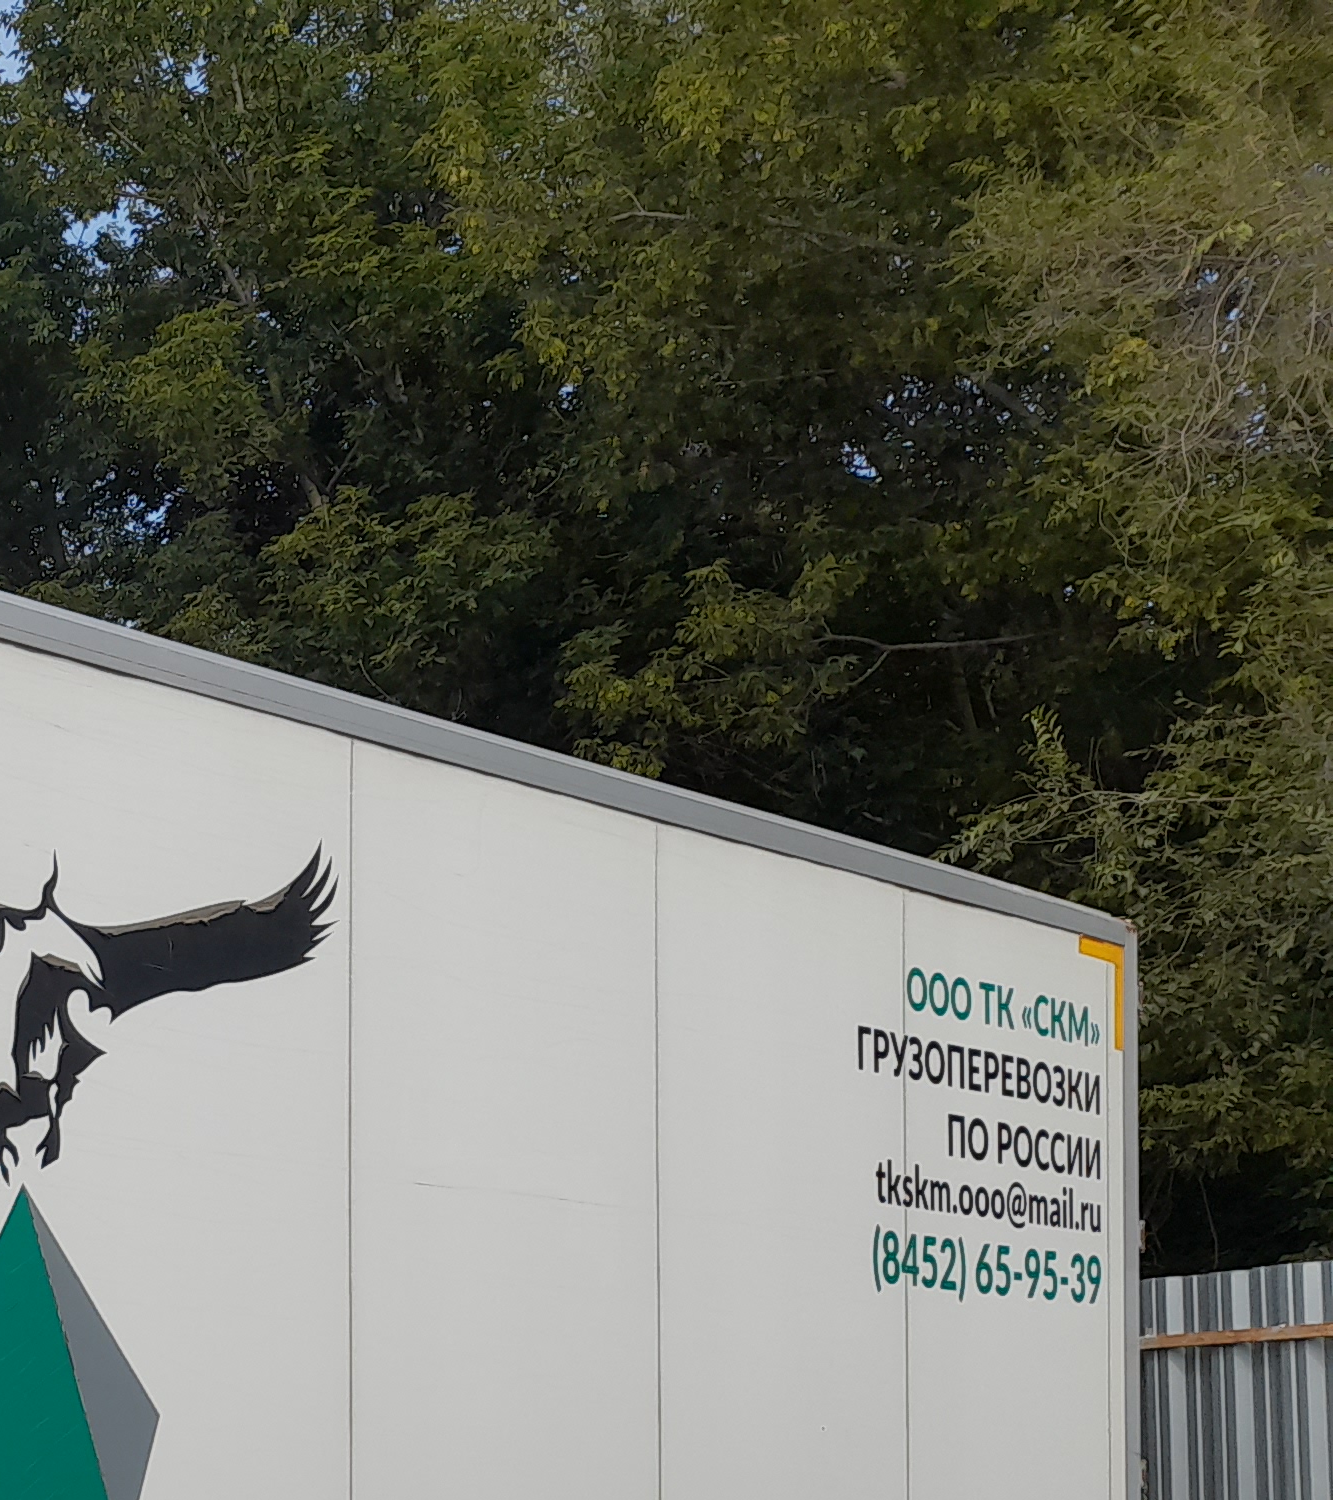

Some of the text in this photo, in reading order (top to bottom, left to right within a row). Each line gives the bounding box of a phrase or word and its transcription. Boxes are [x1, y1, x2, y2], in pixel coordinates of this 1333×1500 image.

[906, 967, 1100, 1047] ООО ТК «СКМ»
[857, 1025, 1101, 1115] ГРУЗОПЕРЕВОЗКИ
[947, 1113, 1101, 1180] ПО РОССИИ
[876, 1158, 1102, 1233] tkskm.ooo@mail.ru
[873, 1224, 1102, 1304] (8452) 65-95-39
